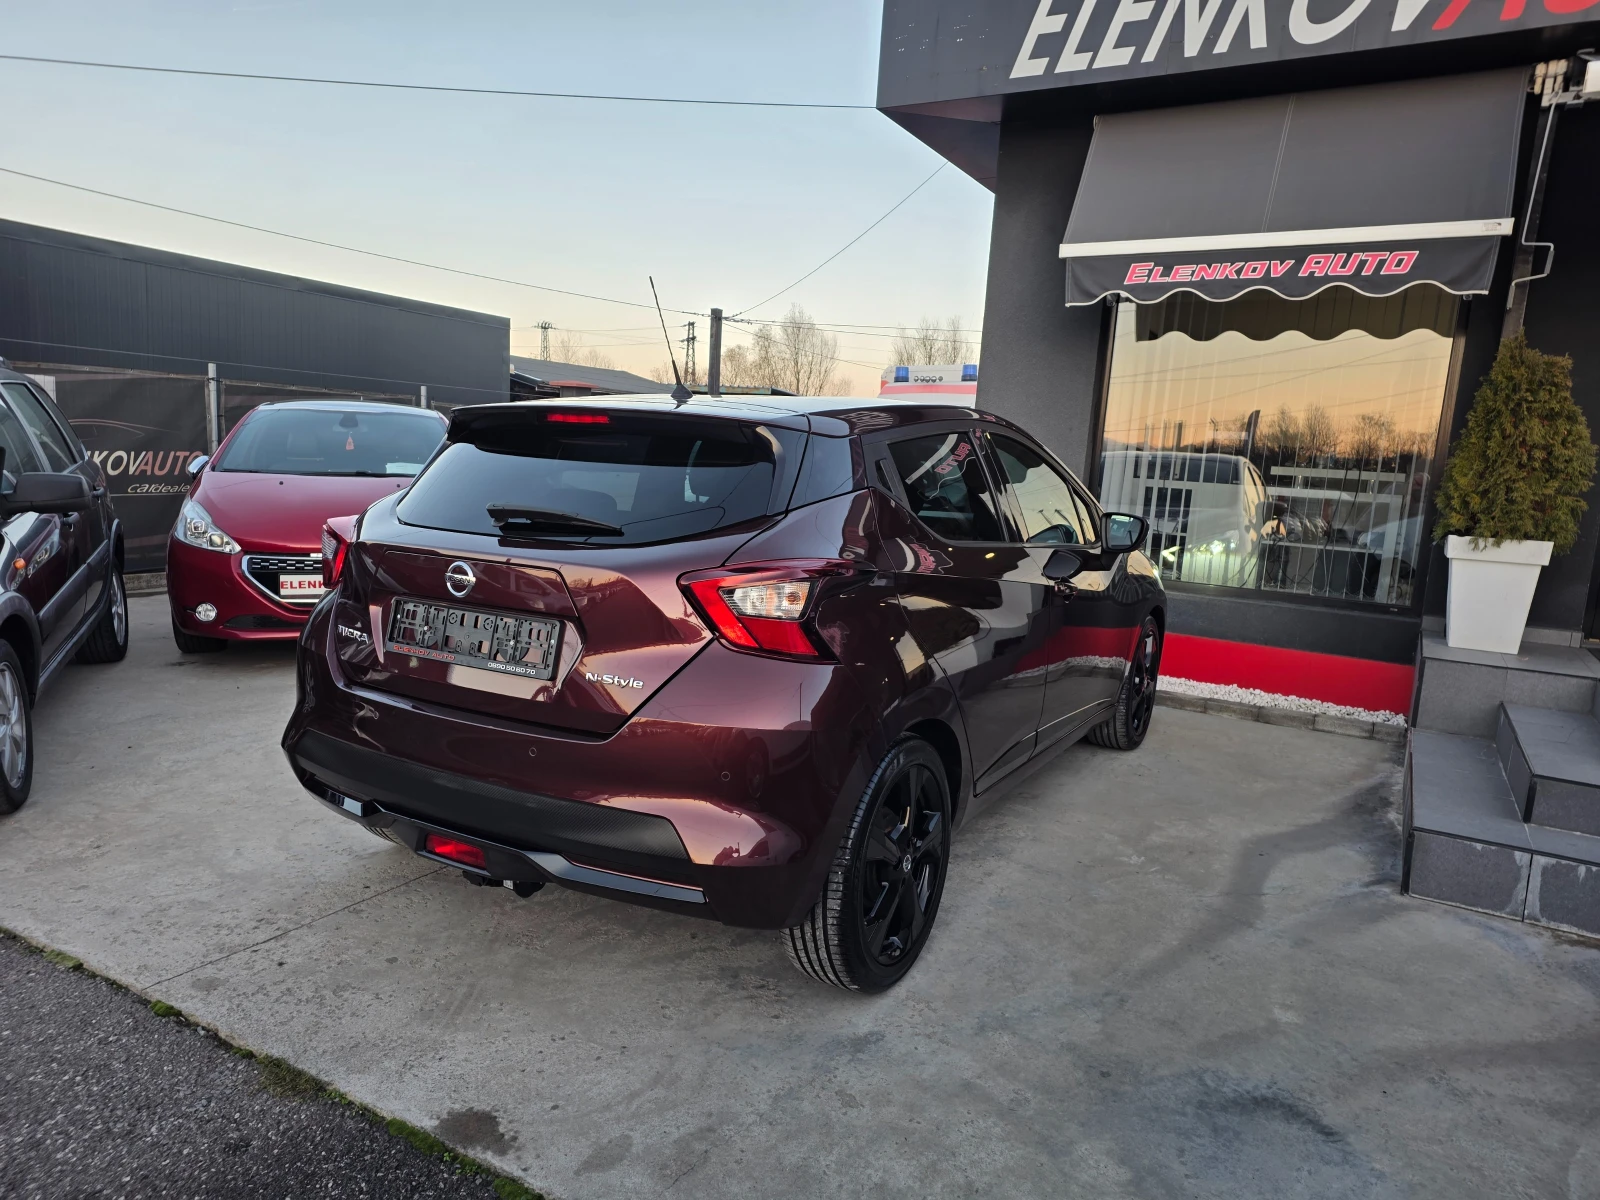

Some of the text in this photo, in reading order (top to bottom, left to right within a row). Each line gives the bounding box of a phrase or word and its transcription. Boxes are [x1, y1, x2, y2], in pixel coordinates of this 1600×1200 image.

[1124, 250, 1419, 284] ELENKOV AUTO
[432, 652, 455, 661] AUTO
[585, 672, 644, 689] N-Style
